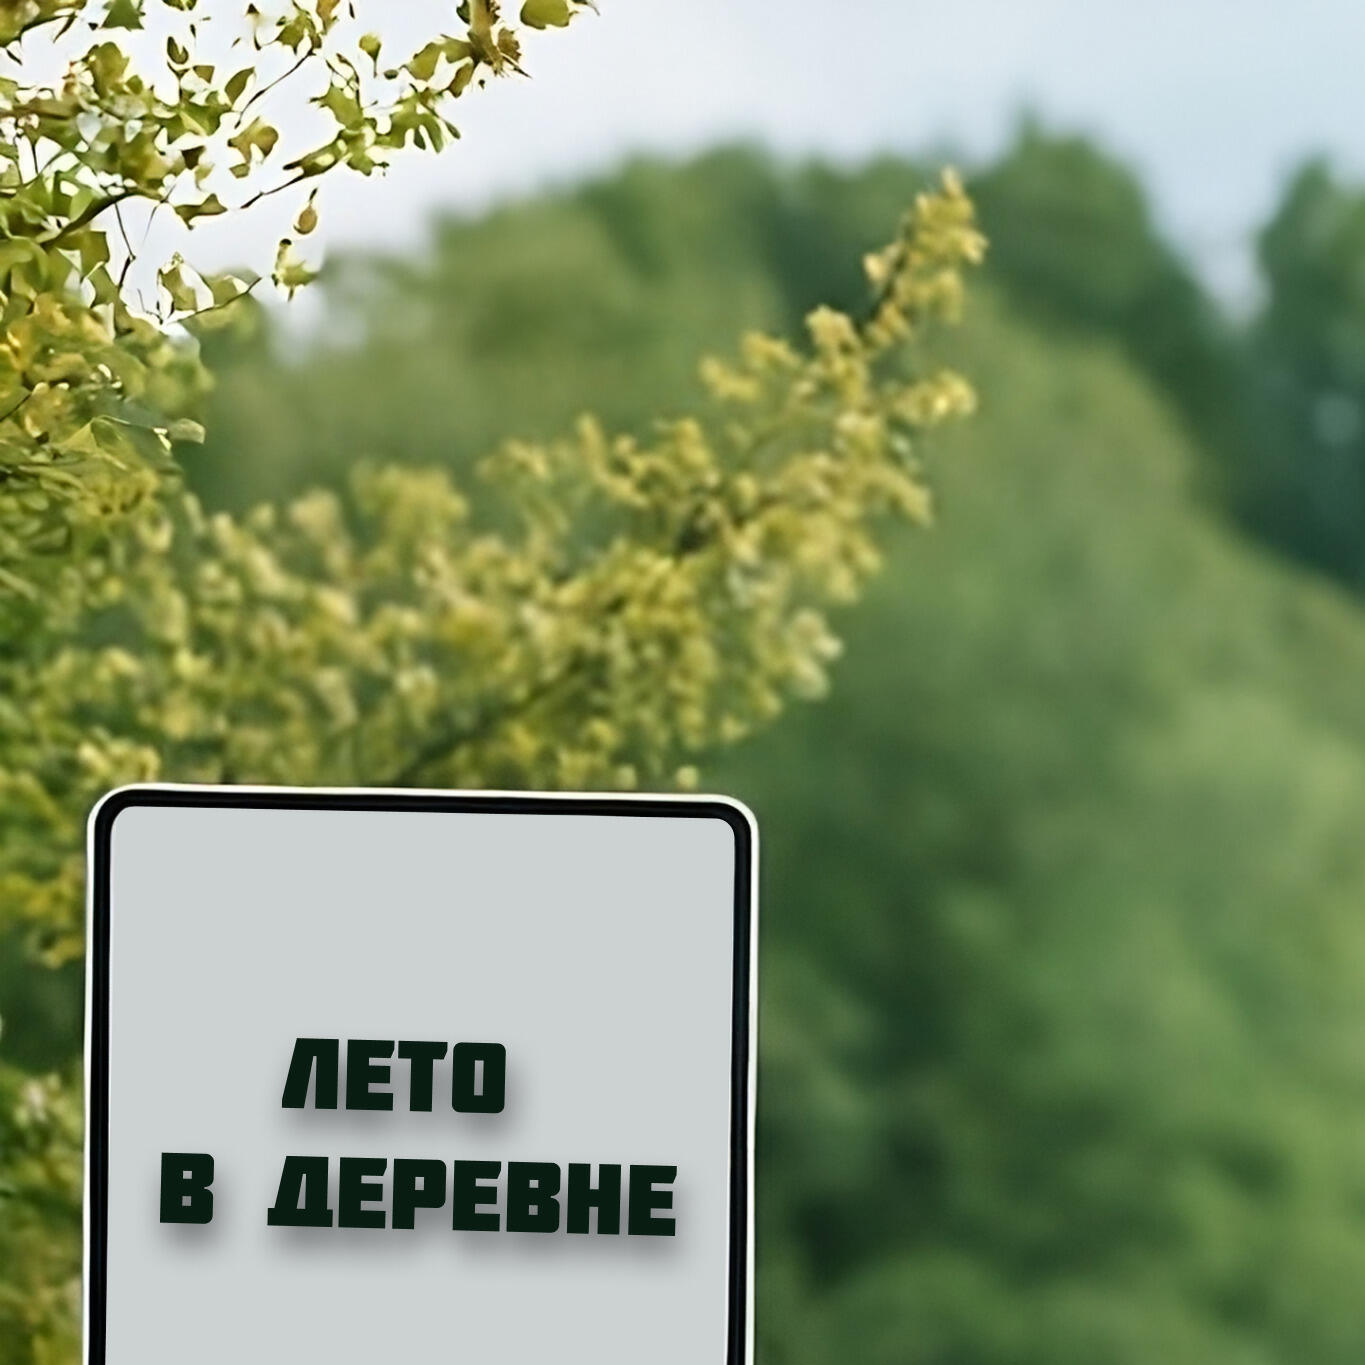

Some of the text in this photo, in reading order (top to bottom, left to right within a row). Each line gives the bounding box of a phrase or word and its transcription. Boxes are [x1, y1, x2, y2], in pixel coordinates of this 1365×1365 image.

[281, 1037, 507, 1114] ЛЕТО
[159, 1152, 678, 1237] В ДЕРЕВНЕ
